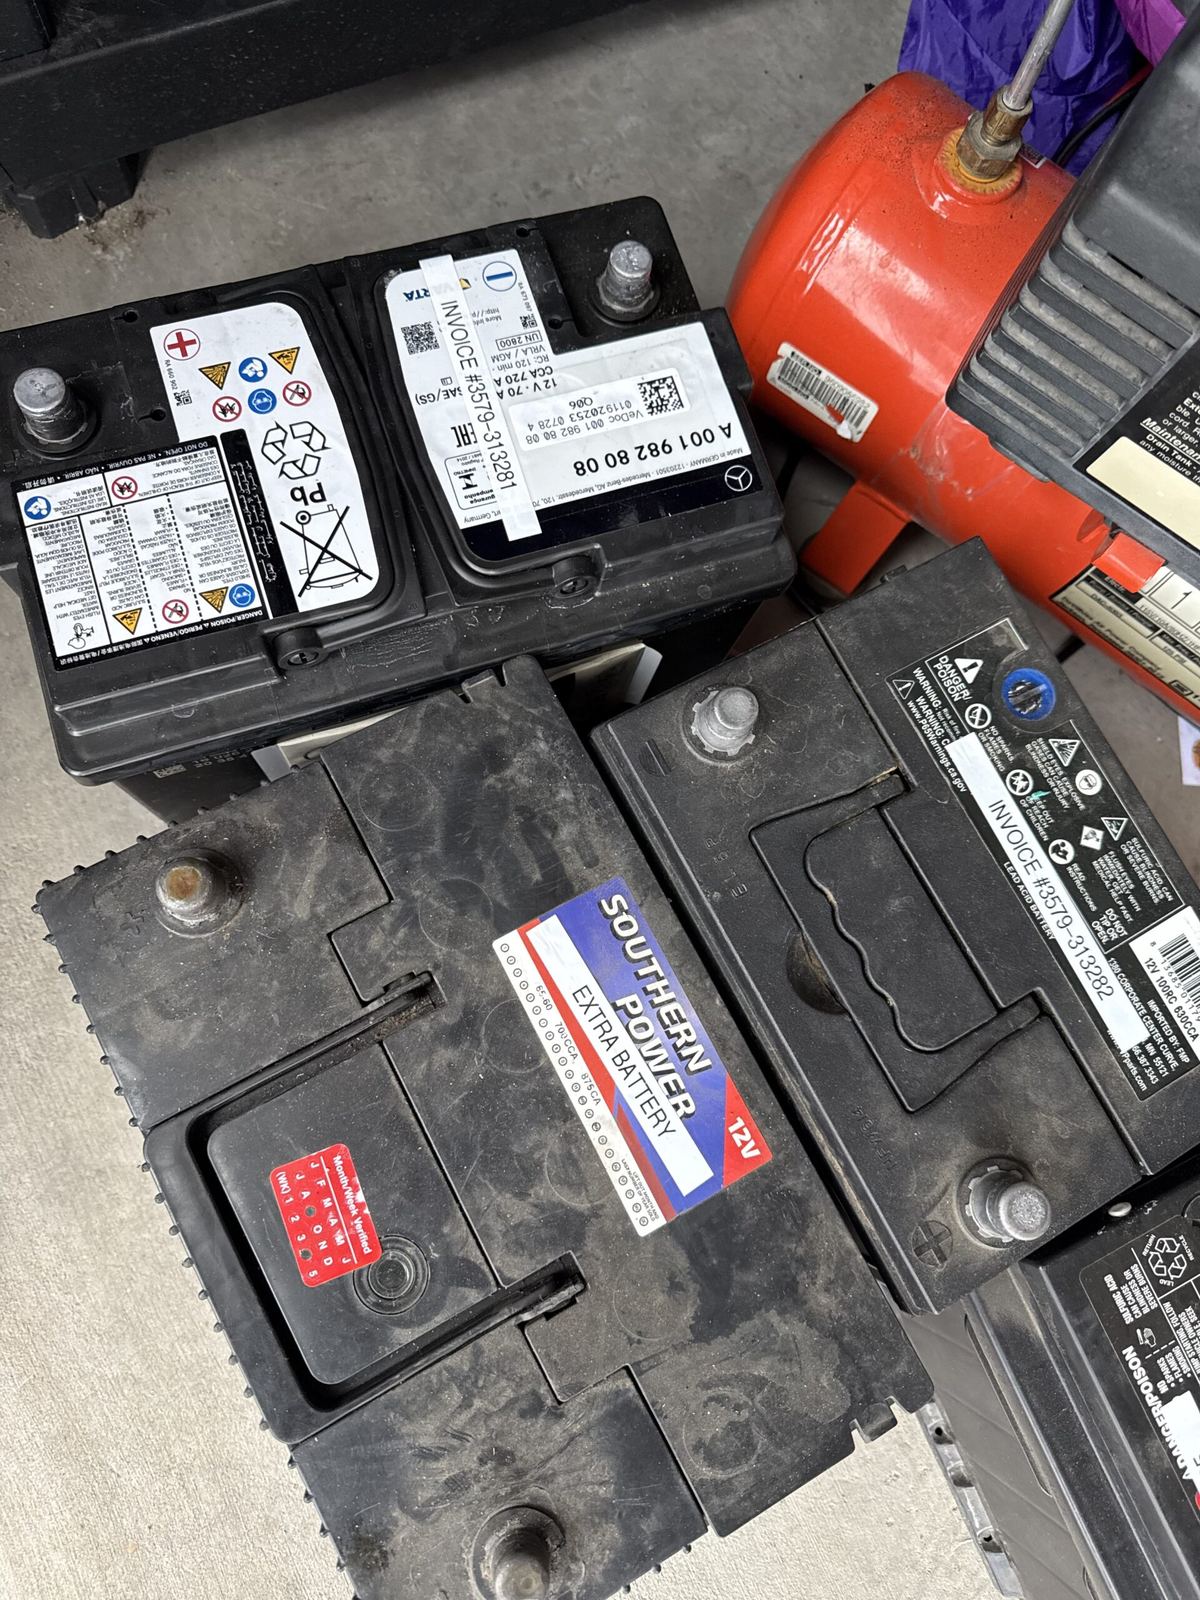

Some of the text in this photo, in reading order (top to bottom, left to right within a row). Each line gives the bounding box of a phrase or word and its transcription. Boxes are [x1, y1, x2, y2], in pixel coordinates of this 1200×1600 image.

[471, 307, 500, 318] http://p
[490, 344, 546, 364] VRLA AGM
[497, 332, 540, 349] UN 2800
[492, 365, 554, 388] CCA 720 A
[496, 353, 550, 373] RC: 120 min
[440, 300, 479, 371] INVOICE
[464, 373, 518, 490] #3579-313281
[495, 377, 558, 400] 12 V 70 A
[1182, 397, 1200, 415] Ext
[525, 409, 644, 445] VeDoc 001 982 80 08
[527, 399, 632, 432] 011920253 0728 4
[1168, 412, 1191, 430] cord.
[1175, 404, 1191, 419] ble.
[573, 422, 732, 477] A 001 982 80 08
[1139, 417, 1200, 461] Maintenan
[1145, 433, 1197, 468] Drain Tank
[1162, 418, 1199, 448] or larger.
[655, 463, 686, 476] 12203501
[689, 454, 720, 468] GERMANY
[1139, 439, 1192, 477] any moisture
[594, 483, 606, 491] AG,
[606, 471, 652, 488] Mercedes-Benz
[540, 495, 556, 505] 120,
[912, 666, 942, 711] WARNING:
[932, 660, 964, 702] POISON
[938, 654, 973, 701] DANGER/
[915, 695, 945, 739] WARNING:
[989, 725, 999, 736] NO
[906, 700, 971, 792] www.P65Warnings.ca.gov
[977, 731, 1006, 772] OR SMOKING
[983, 728, 1003, 755] FLAMES
[1019, 798, 1049, 842] OF CHILDREN
[1030, 791, 1055, 824] EEP OUT
[1031, 805, 1050, 829] REACH
[1065, 865, 1098, 912] INSTRUCTIONS
[1071, 862, 1086, 882] READ
[988, 799, 1115, 1001] INVOICE #3579-313282
[1003, 861, 1057, 940] LEAD ACID BATTERY
[1091, 920, 1110, 945] OPEN.
[1099, 914, 1119, 941] TIP OR
[1104, 907, 1129, 937] DO NOT
[601, 894, 712, 1072] SOUTHERN
[1160, 959, 1182, 989] 13685
[1144, 957, 1200, 1043] 12V 100RC 630CCA
[1114, 972, 1148, 1017] CORPORATE
[1142, 1015, 1164, 1045] CENTER
[1159, 1043, 1180, 1072] CURVE,
[1146, 999, 1191, 1063] IMPORTED BY: FMP
[571, 984, 620, 1052] EXTRA
[611, 1048, 677, 1137] BATTERY
[616, 993, 696, 1120] POWER
[1131, 1045, 1160, 1085] 66.387.3343
[1144, 1042, 1170, 1078] MN 55121
[728, 1116, 761, 1159] 12V
[295, 1173, 334, 1266] J A O N D
[310, 1161, 320, 1169] J
[316, 1179, 327, 1187] F
[322, 1197, 333, 1208] M
[328, 1218, 339, 1227] A
[334, 1234, 346, 1246] M
[332, 1154, 373, 1255] Month/Week Verified
[275, 1171, 318, 1278] (WK) 1 2 3 5
[1178, 1234, 1195, 1261] RECYCLE
[1103, 1273, 1135, 1325] SULFURIC ACID
[1120, 1283, 1143, 1319] CAN CAUSE
[1123, 1268, 1151, 1315] BLINDNESS OR
[1130, 1263, 1159, 1310] SEVERE BURNS
[1162, 1301, 1181, 1328] FOLLOW
[1177, 1311, 1197, 1340] OWNERS
[1184, 1305, 1198, 1323] SEEK
[1171, 1345, 1191, 1375] SMOKING
[1174, 1324, 1196, 1361] STARTING,
[1156, 1356, 1175, 1384] SPARKS
[1164, 1351, 1183, 1379] FLAMES
[1156, 1379, 1169, 1395] NO
